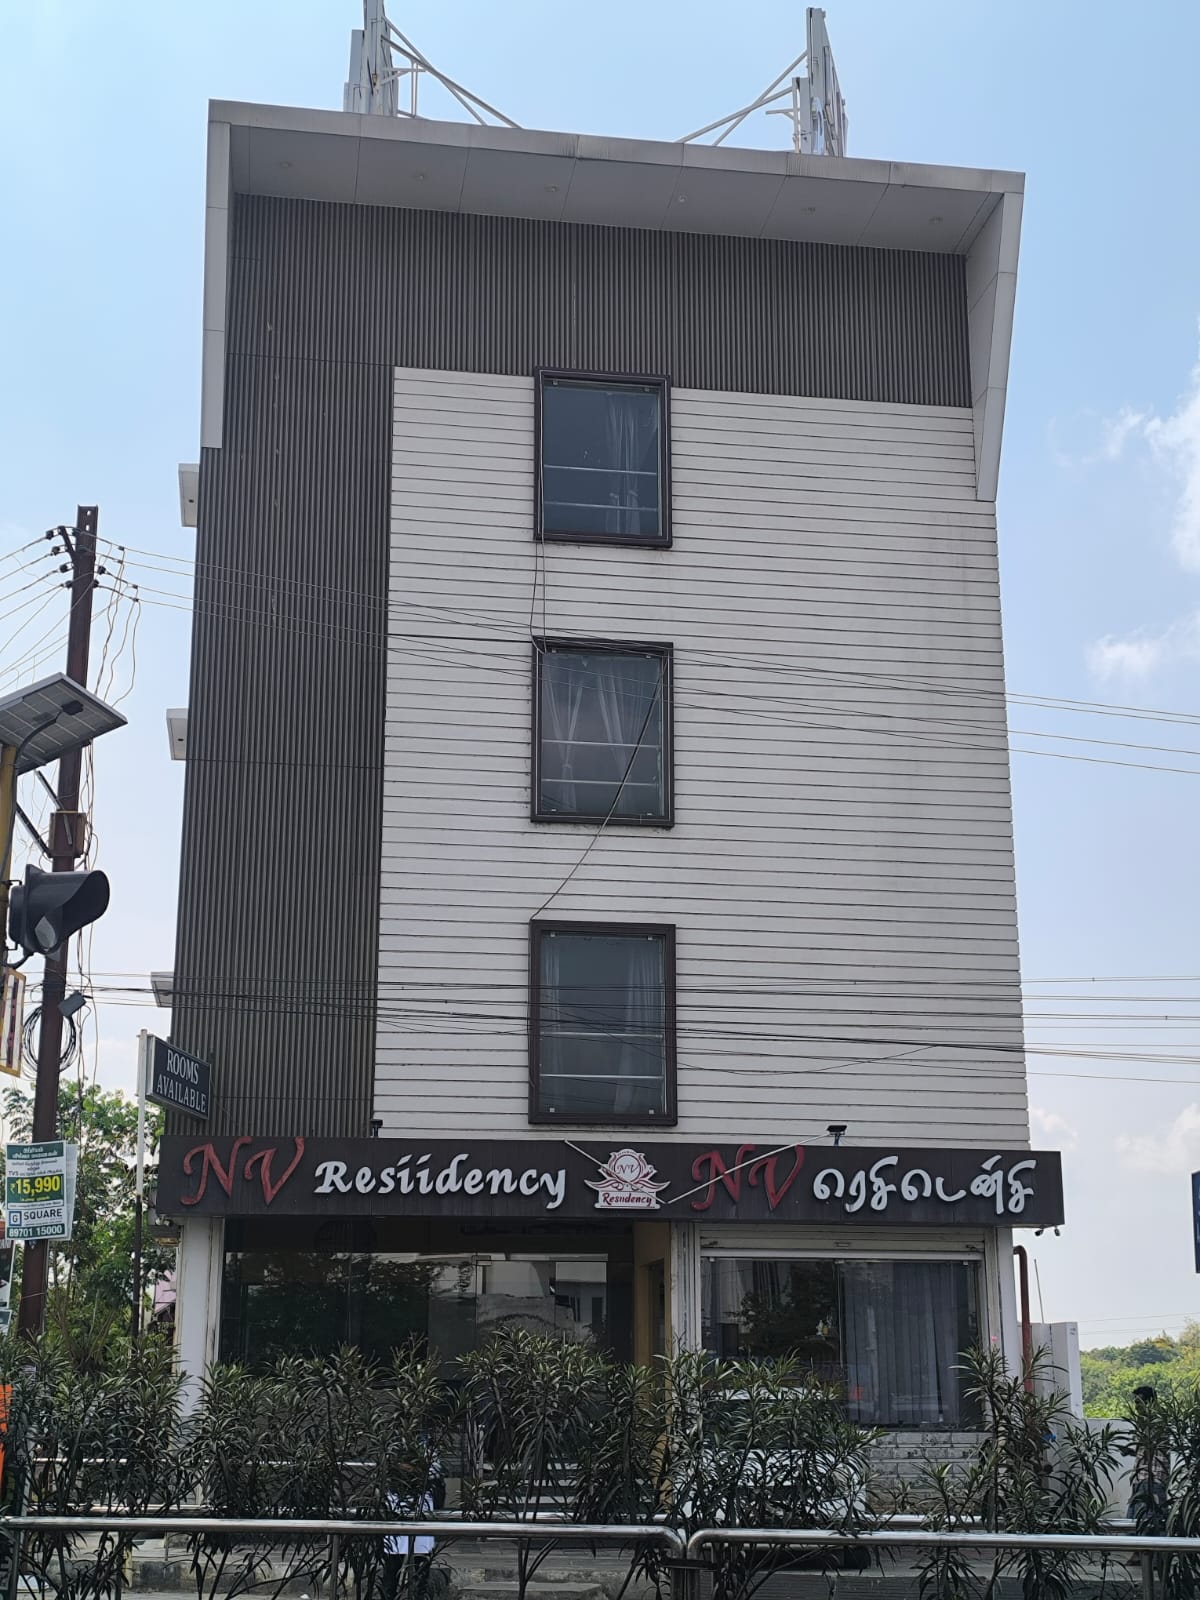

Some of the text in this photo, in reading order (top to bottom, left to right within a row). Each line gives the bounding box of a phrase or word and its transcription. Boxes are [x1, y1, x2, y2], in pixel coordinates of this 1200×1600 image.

[167, 1049, 199, 1085] ROOMS
[156, 1074, 207, 1113] AVAILABLE
[180, 1136, 567, 1209] NV Resiidency
[691, 1144, 1037, 1214] NV ரெசிடென்சி
[9, 1225, 62, 1237] 89701 15000
[23, 1208, 62, 1221] SQUARE
